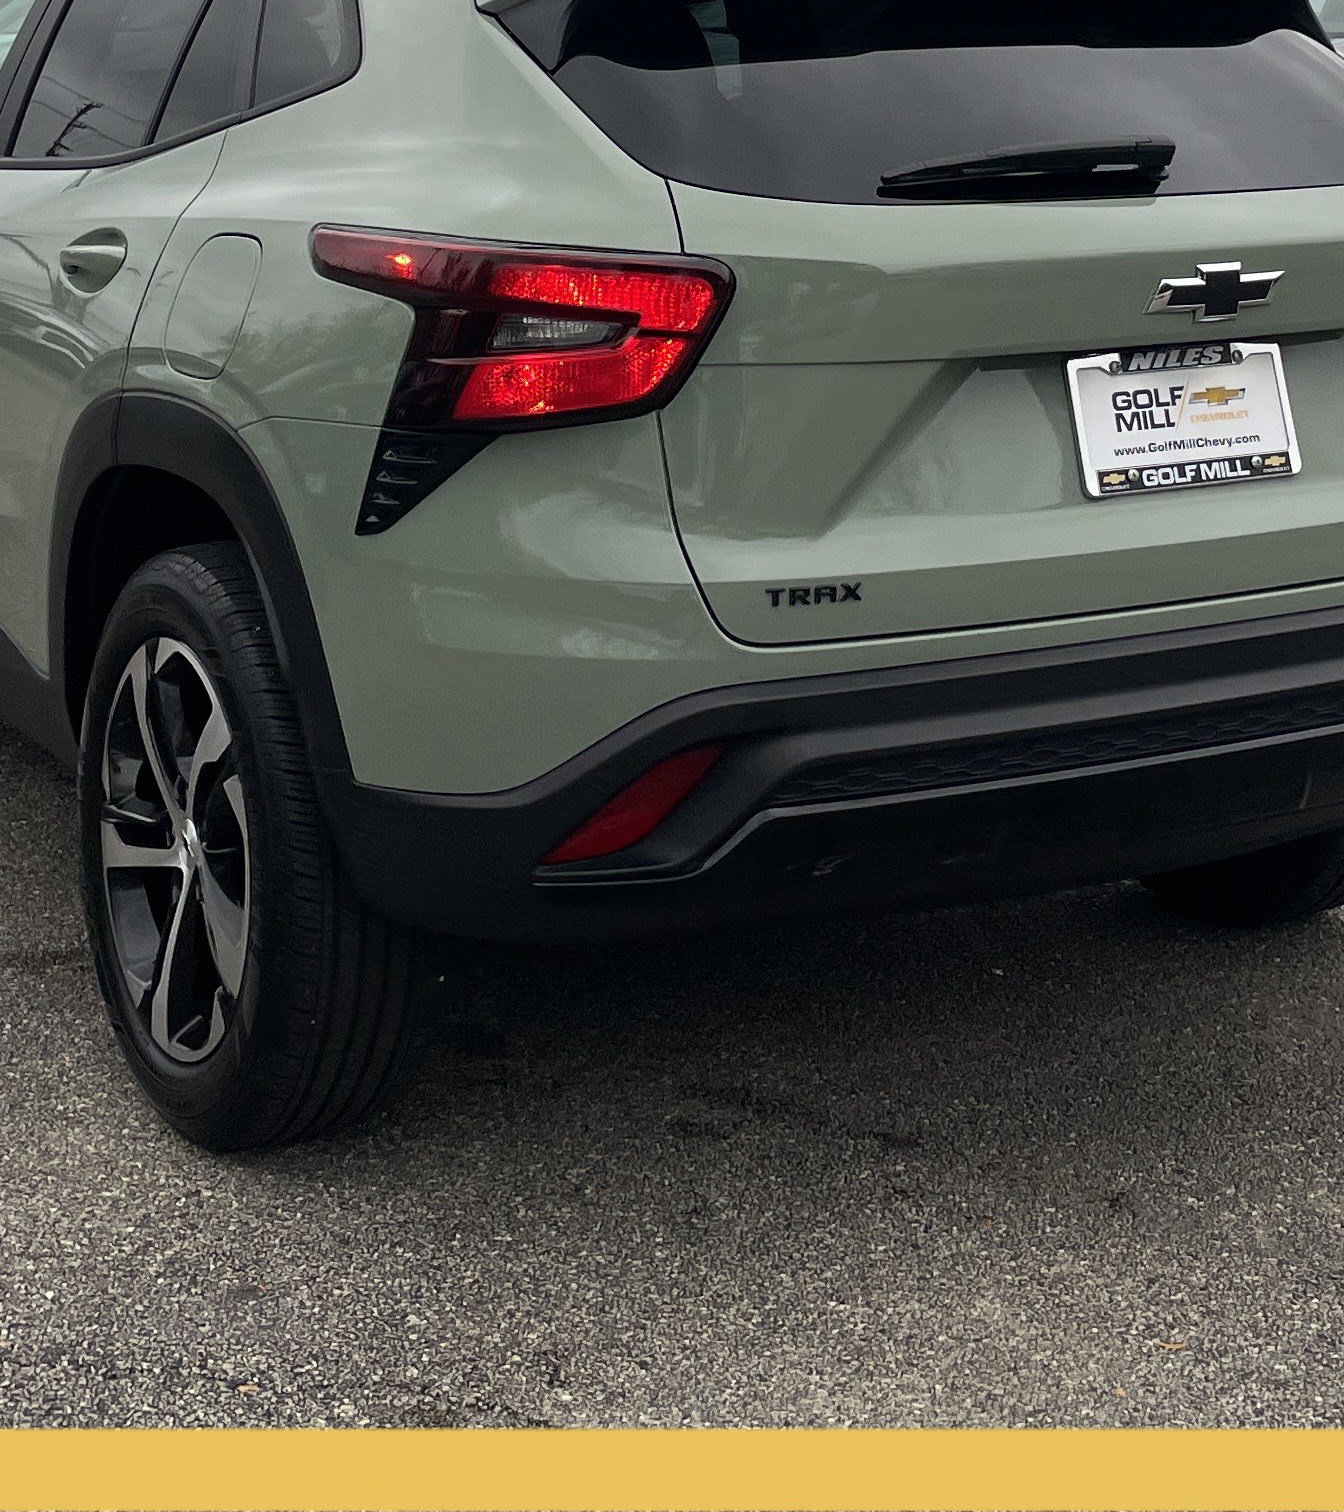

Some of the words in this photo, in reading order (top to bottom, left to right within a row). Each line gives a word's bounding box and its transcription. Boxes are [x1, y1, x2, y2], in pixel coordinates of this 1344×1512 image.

[1128, 345, 1224, 371] NILES
[1111, 386, 1185, 411] GOLF
[1114, 408, 1176, 433] MILL
[1189, 409, 1250, 424] CHEVROLET
[1113, 434, 1261, 457] www.GolfMillChevy.com
[1142, 464, 1197, 487] GOLF
[1200, 459, 1251, 481] MILL
[764, 581, 863, 607] TRAX
